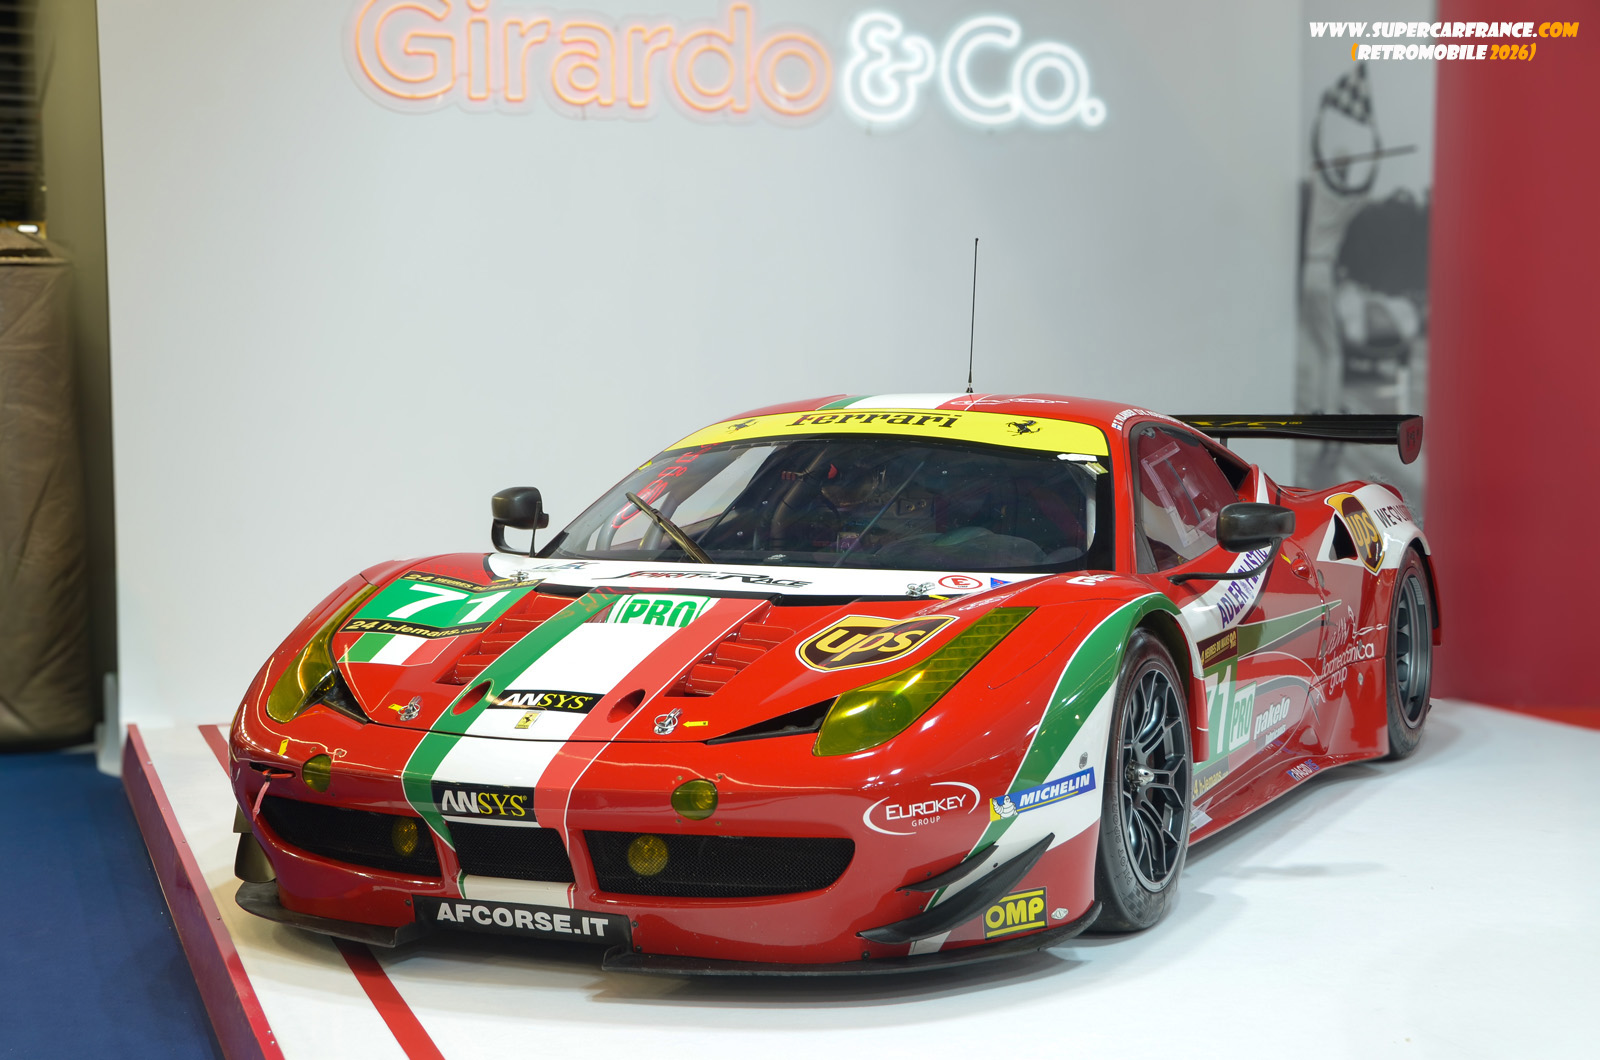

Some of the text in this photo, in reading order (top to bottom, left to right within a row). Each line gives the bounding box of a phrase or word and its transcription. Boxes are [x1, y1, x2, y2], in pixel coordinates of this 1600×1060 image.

[786, 411, 962, 428] Ferrari
[1346, 512, 1379, 558] ups
[403, 574, 435, 582] 24
[386, 583, 511, 625] 71
[619, 598, 697, 628] PRO
[1217, 580, 1249, 629] ADLER
[345, 620, 483, 638] 24 h-lemans.com
[815, 628, 926, 662] ups
[1230, 693, 1253, 744] PRO
[1253, 696, 1290, 741] pakelo
[1019, 772, 1091, 807] MICHELIN
[885, 793, 967, 821] EUROKEY
[911, 815, 941, 828] GROUP
[437, 902, 609, 937] AFCORSE.IT
[985, 896, 1045, 929] OMP
